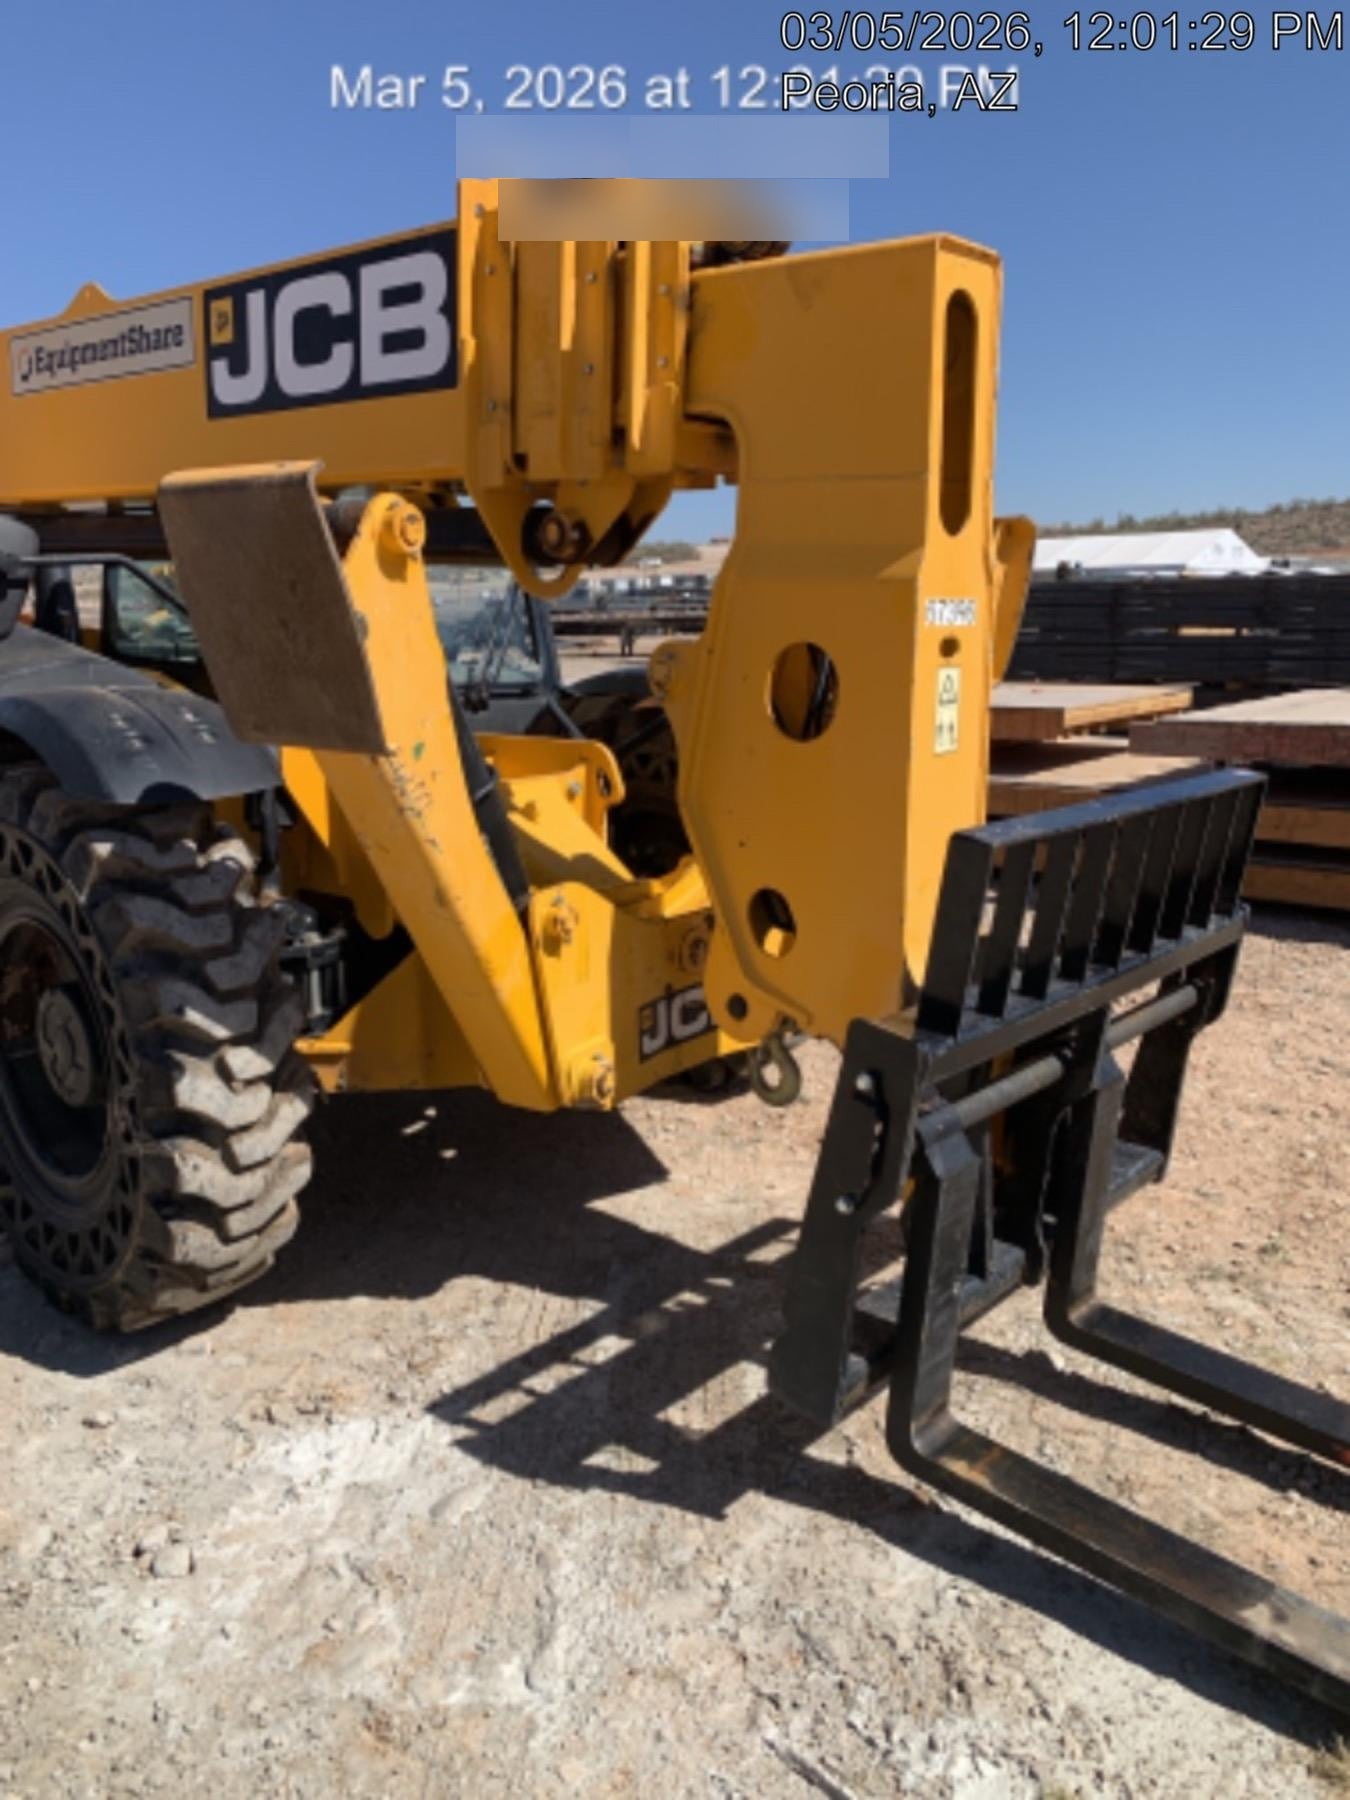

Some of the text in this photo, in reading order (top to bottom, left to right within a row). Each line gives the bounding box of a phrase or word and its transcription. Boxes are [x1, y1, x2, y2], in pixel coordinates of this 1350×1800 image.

[35, 323, 184, 377] EquipmentShare
[210, 250, 450, 405] JCB
[641, 986, 714, 1055] JC
